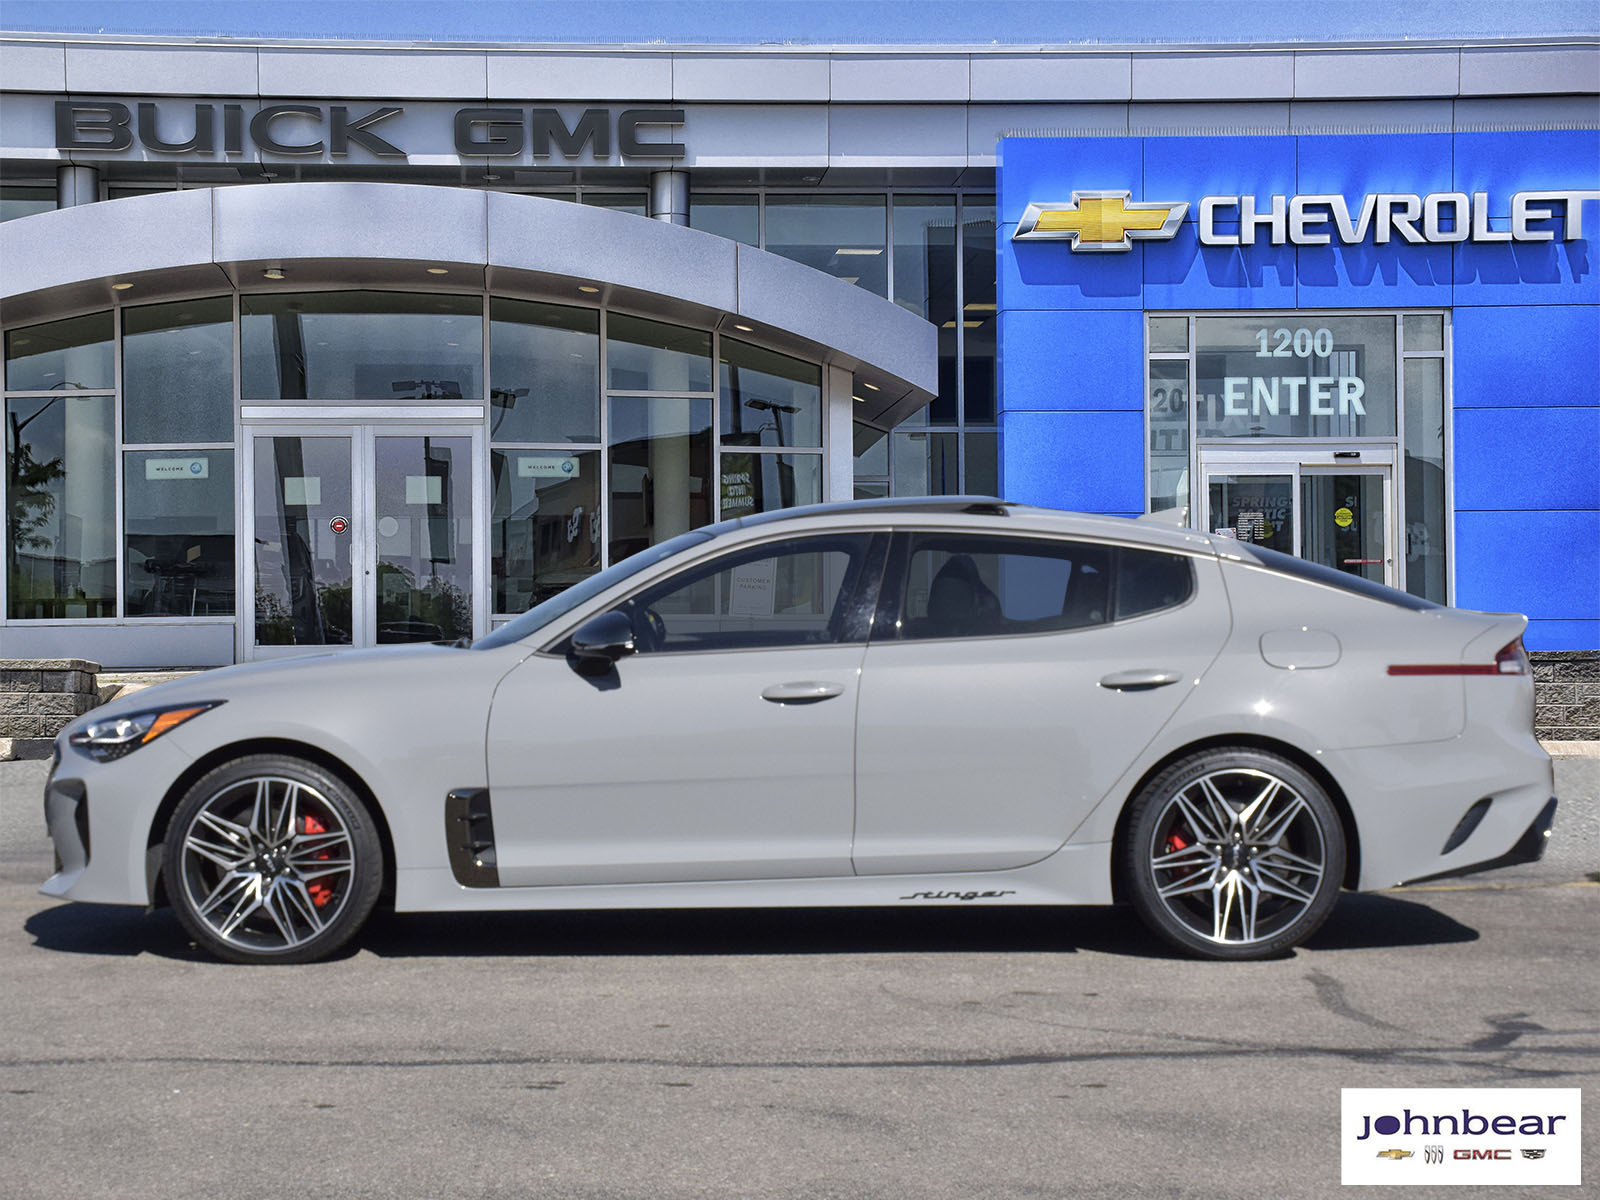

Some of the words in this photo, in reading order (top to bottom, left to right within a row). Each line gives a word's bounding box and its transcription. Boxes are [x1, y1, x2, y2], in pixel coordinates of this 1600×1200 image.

[55, 100, 406, 157] BUICK
[455, 106, 686, 158] GMC
[1199, 190, 1600, 244] CHEVROLET
[1255, 328, 1334, 358] 1200
[1223, 376, 1367, 416] ENTER
